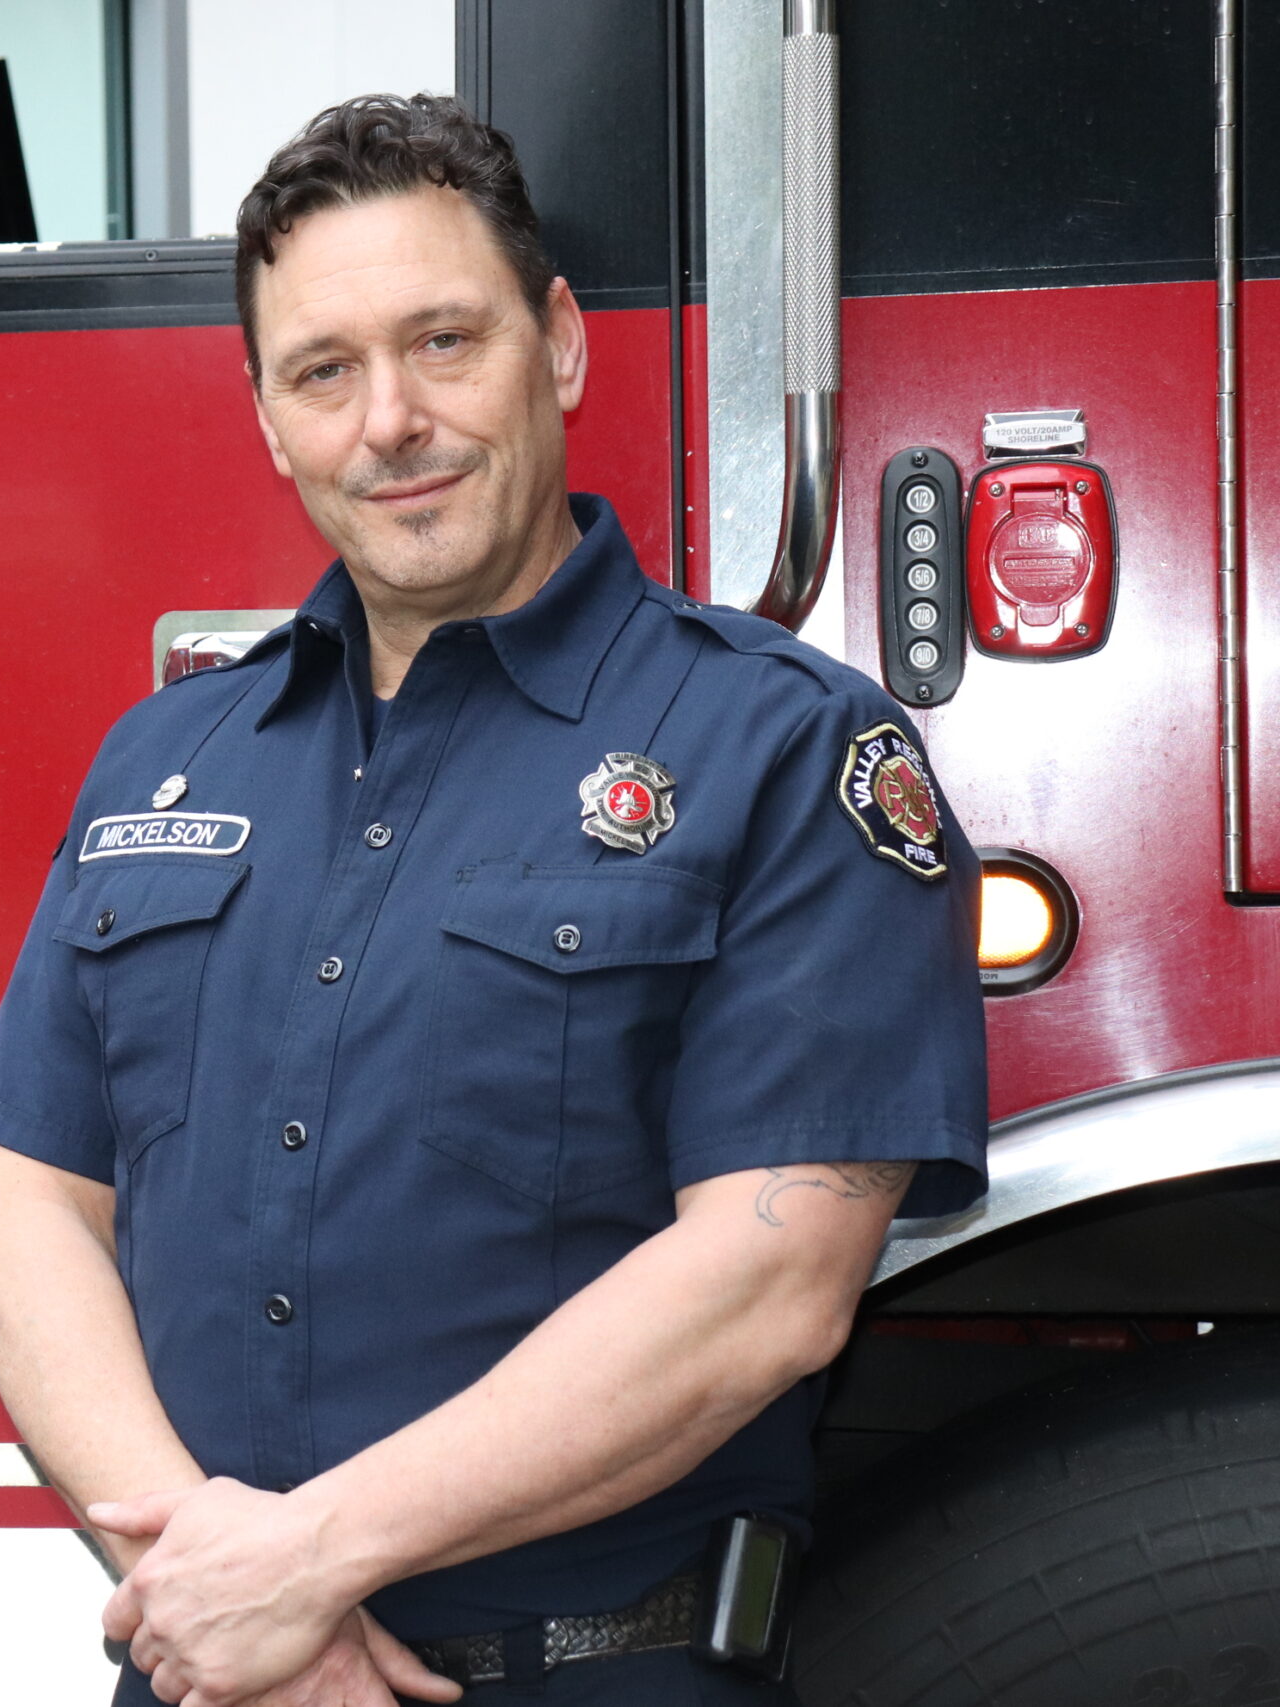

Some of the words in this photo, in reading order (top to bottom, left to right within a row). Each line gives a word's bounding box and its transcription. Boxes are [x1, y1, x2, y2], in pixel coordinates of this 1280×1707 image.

[996, 428, 1012, 436] 120
[1014, 425, 1073, 436] VOLT/20AMP
[1007, 434, 1061, 444] SHORELINE
[913, 491, 929, 508] 1/2
[913, 530, 929, 547] 3/4
[915, 569, 930, 585] 5/6
[916, 608, 931, 625] 7/8
[916, 647, 932, 664] 9/0
[853, 738, 887, 809] VALLEY
[96, 820, 221, 850] MICKELSON
[904, 843, 938, 865] FIRE
